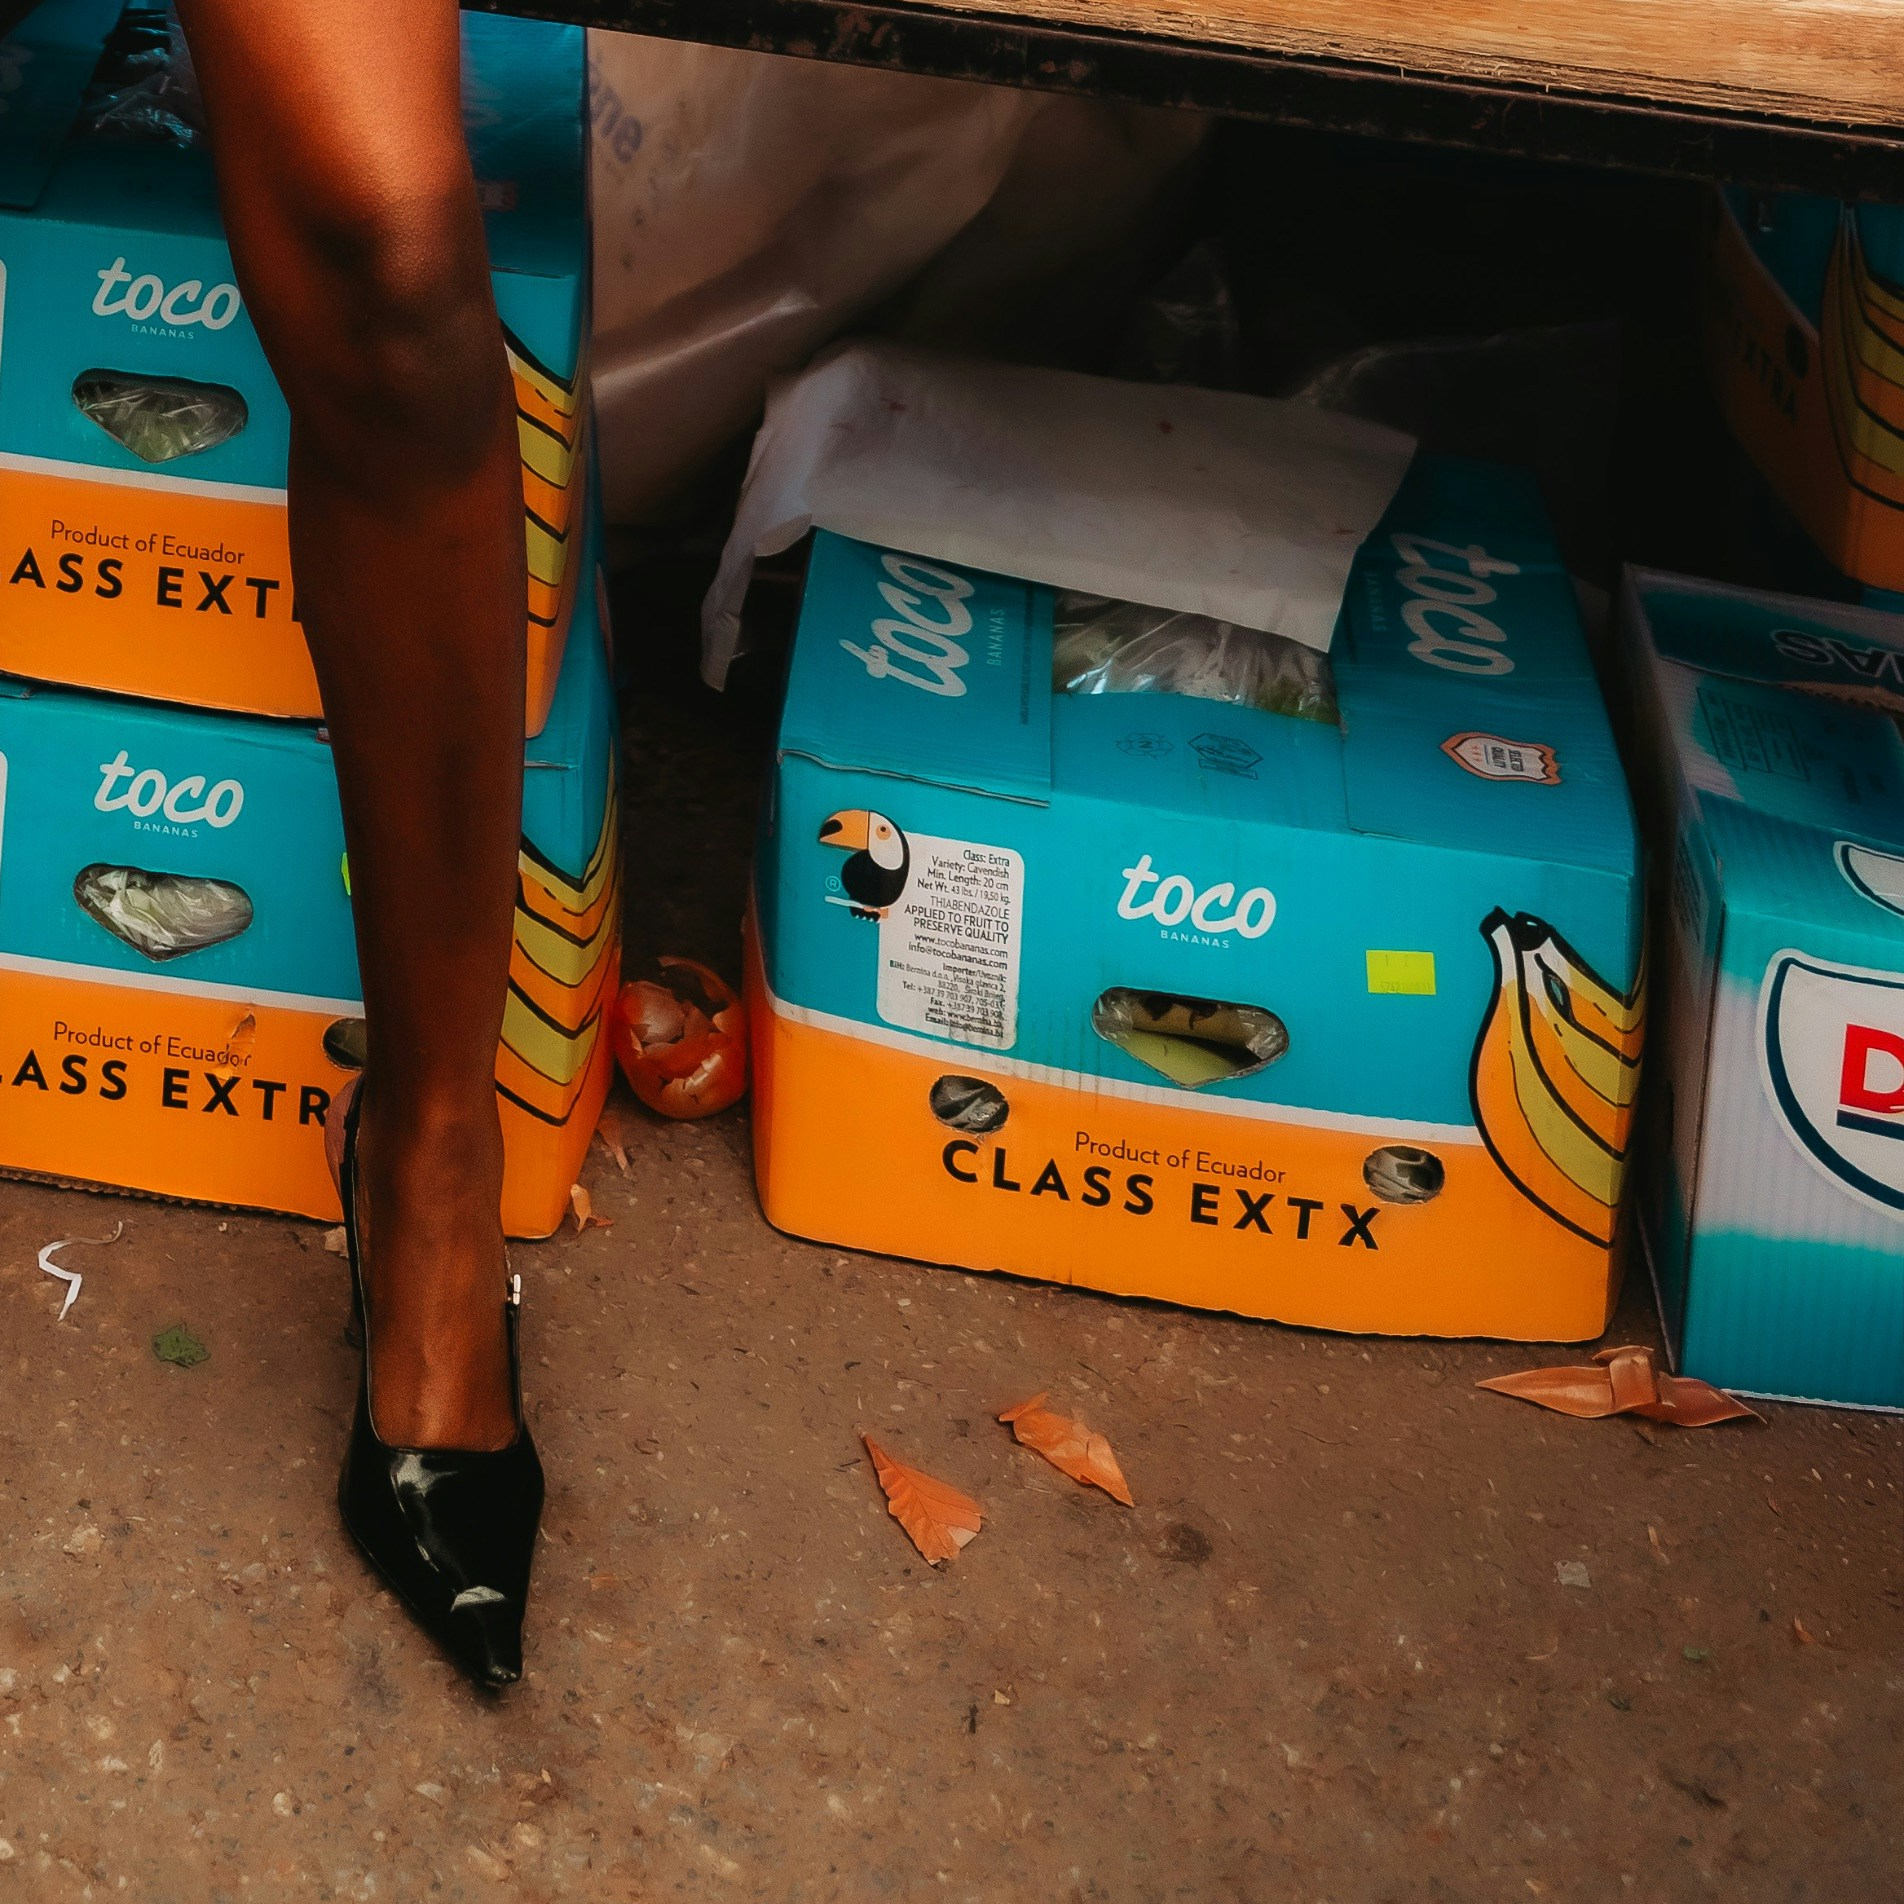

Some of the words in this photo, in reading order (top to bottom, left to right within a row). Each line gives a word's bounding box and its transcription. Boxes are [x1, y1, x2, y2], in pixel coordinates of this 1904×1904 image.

[92, 257, 241, 330] toco
[131, 324, 194, 339] BANANAS
[51, 520, 129, 550] Product
[135, 533, 157, 554] of
[162, 536, 245, 565] Ecuador
[156, 565, 301, 622] EXT
[1390, 532, 1520, 675] toco
[838, 553, 975, 697] toco
[986, 608, 1005, 666] BANANAS
[94, 750, 244, 828] toco
[134, 821, 198, 838] BANANAS
[932, 856, 965, 871] Variety:
[968, 863, 1009, 878] Cavendish
[988, 854, 1010, 866] Extra
[917, 878, 932, 889] Net
[935, 880, 949, 892] Wt.
[951, 886, 960, 894] 43
[928, 867, 945, 879] Min.
[948, 870, 981, 886] Length:
[984, 878, 994, 888] 20
[996, 883, 1008, 891] cm
[931, 896, 1010, 919] THIABENDAZOLE
[1117, 854, 1276, 939] toco
[904, 904, 945, 920] APPLIED
[948, 912, 961, 923] TO
[964, 915, 992, 928] FRUIT
[995, 921, 1008, 932] TO
[914, 918, 962, 936] PRESERVE
[965, 927, 1008, 944] QUALITY
[914, 934, 1008, 958] www.tocobananas.com
[1161, 929, 1230, 949] BANANAS
[908, 941, 1008, 970] info@tocobananas.com
[54, 1021, 133, 1052] Product
[140, 1034, 162, 1055] of
[167, 1037, 252, 1067] Ecuador
[1074, 1131, 1160, 1166] Product
[1167, 1149, 1190, 1170] of
[1196, 1151, 1286, 1184] Ecuador
[941, 1139, 1154, 1216] CLASS
